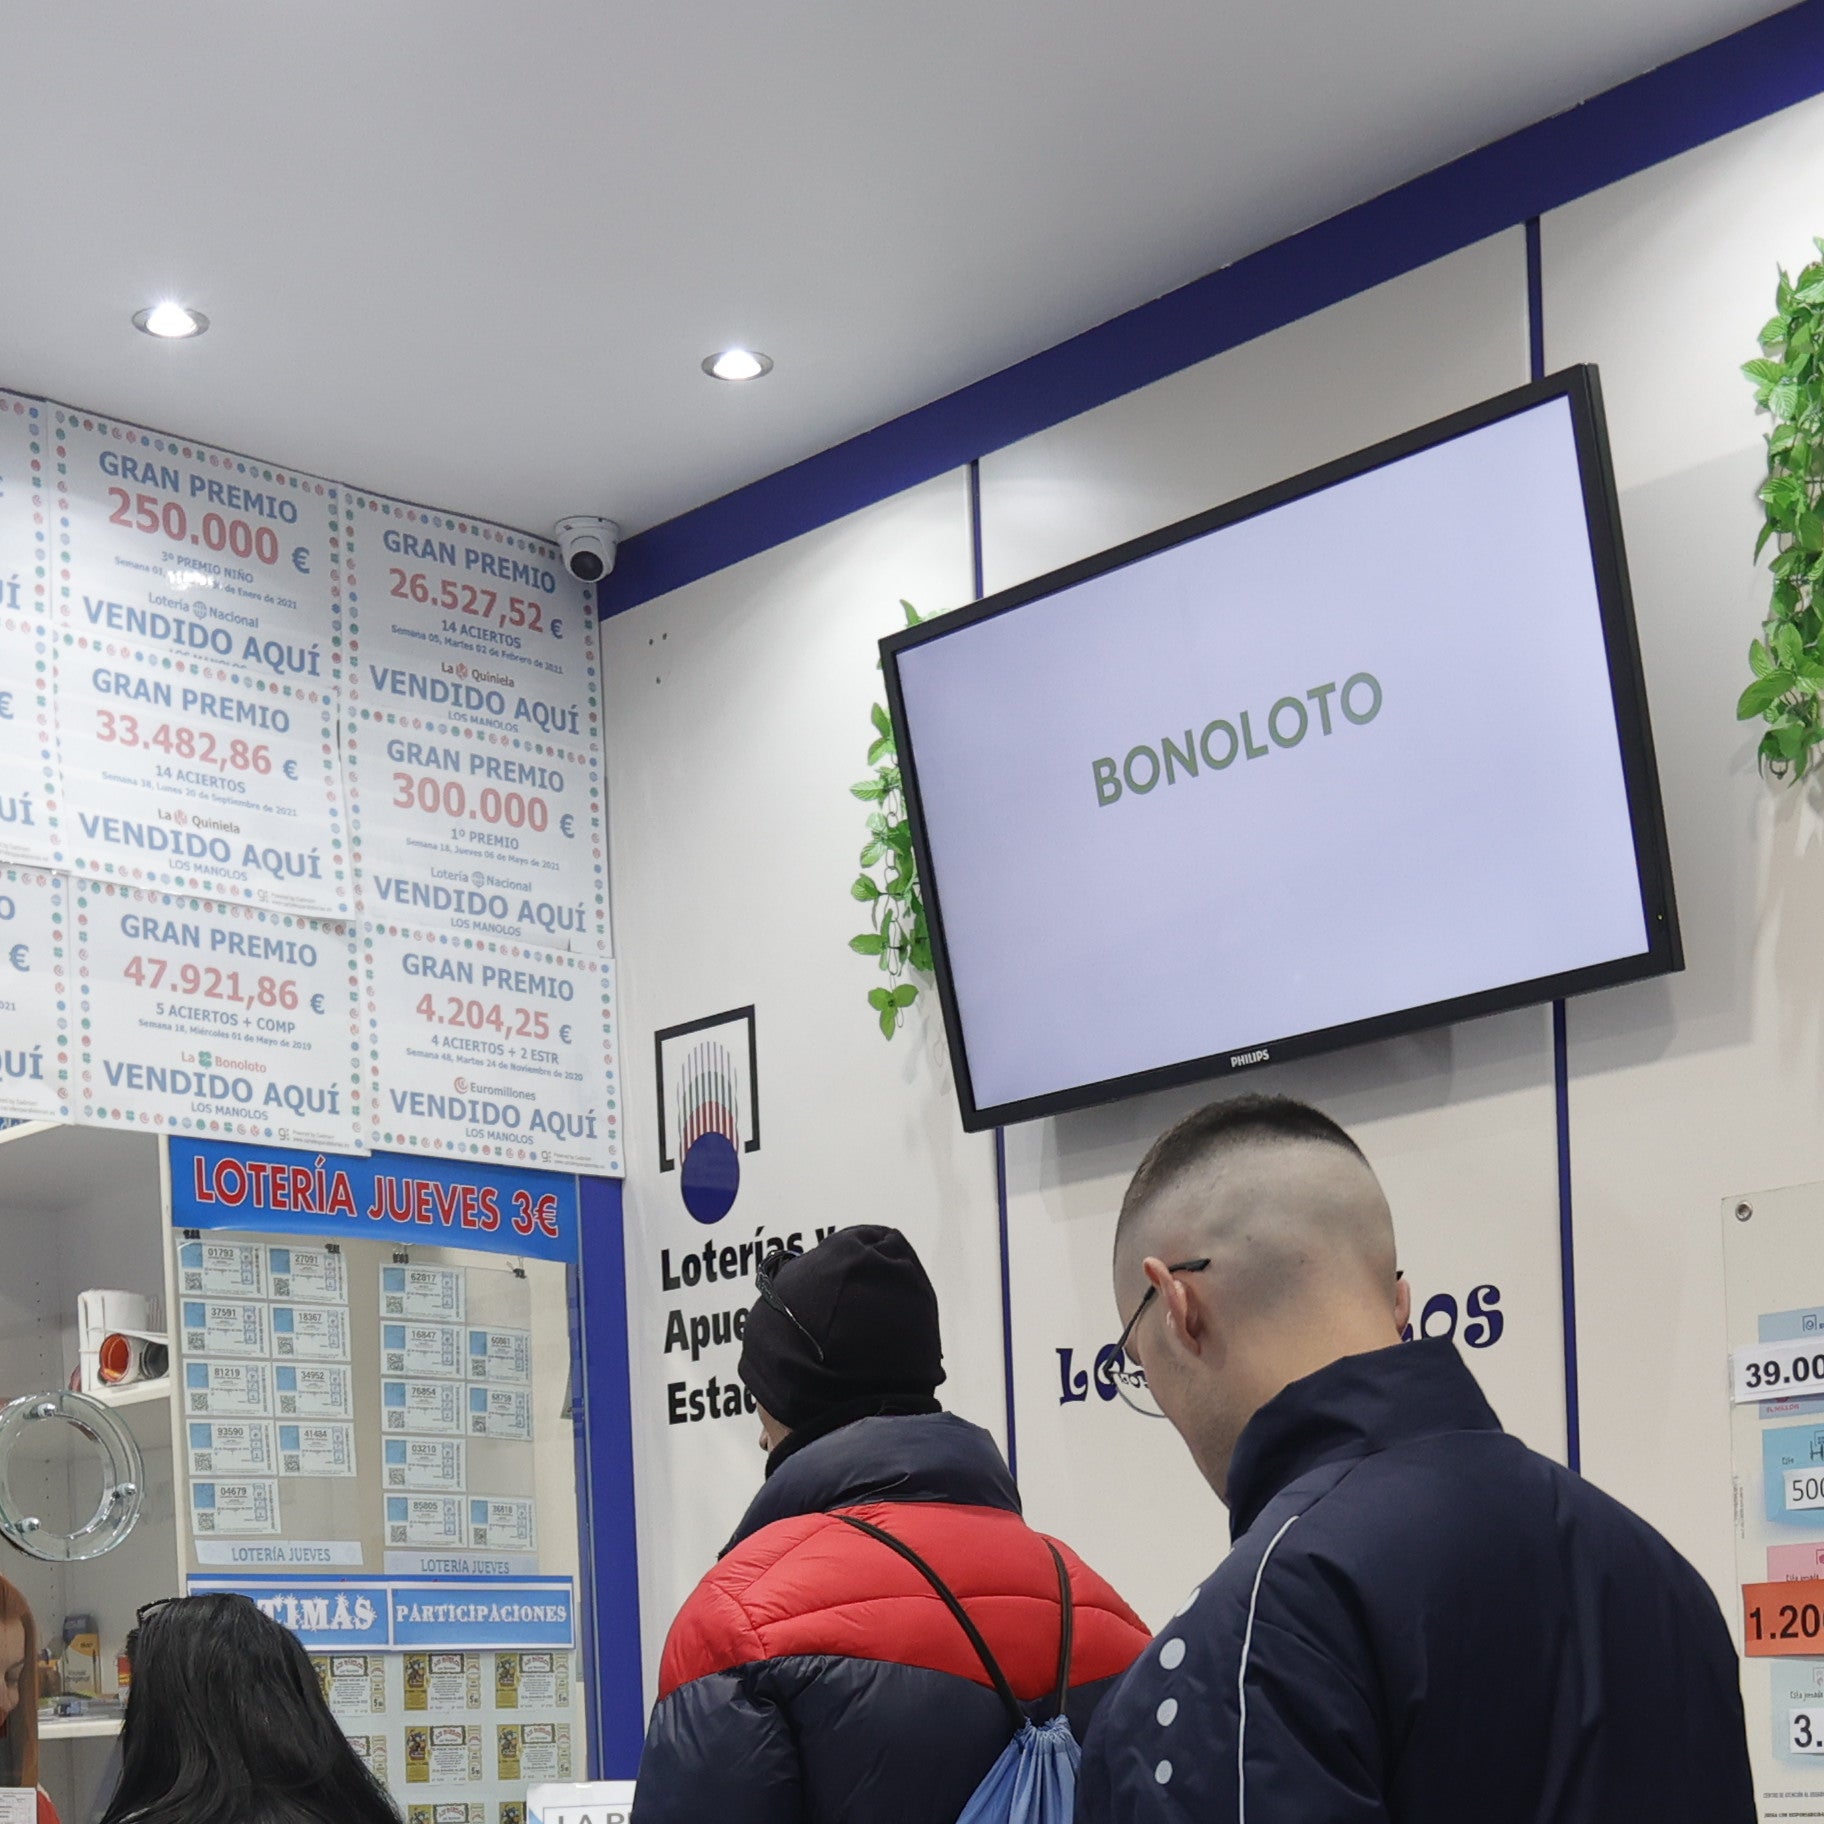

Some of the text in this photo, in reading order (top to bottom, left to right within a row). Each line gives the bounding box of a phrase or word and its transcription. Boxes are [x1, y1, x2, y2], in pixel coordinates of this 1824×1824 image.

[107, 485, 278, 567] 250.000
[389, 567, 544, 634] 26.527,52
[95, 709, 272, 777] 33.482,86
[1092, 670, 1385, 809] BONOLOTO
[392, 771, 548, 834] 300.000
[123, 955, 298, 1012] 47.921,86
[416, 993, 550, 1041] 4.204,25
[1230, 1047, 1271, 1070] PHILIPS
[389, 1088, 598, 1141] VENDIDO AQUÍ
[469, 1081, 536, 1102] Euromillones
[193, 1154, 559, 1238] LOTERÍA JUEVES 3€
[232, 1545, 331, 1562] LOTERÍA JUEVES
[421, 1559, 510, 1574] LOTERÍA JUEVES
[396, 1603, 567, 1624] PARTICIPACIONES
